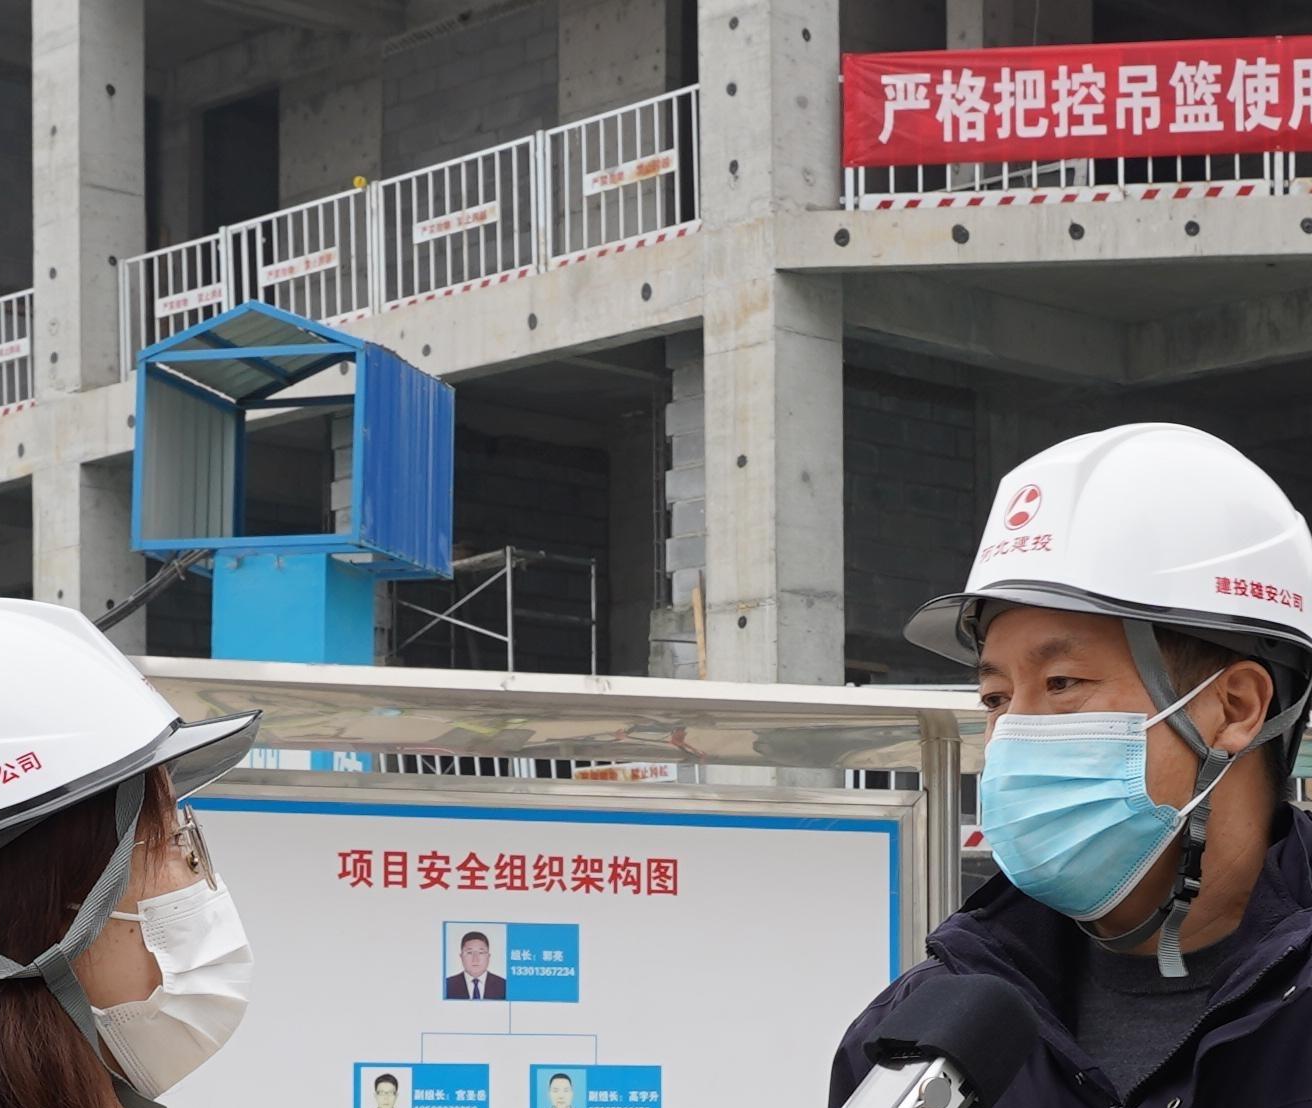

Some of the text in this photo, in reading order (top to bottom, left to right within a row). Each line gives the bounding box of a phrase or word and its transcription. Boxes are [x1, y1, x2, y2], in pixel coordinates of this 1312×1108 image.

[1214, 576, 1304, 612] 建投雄安公司
[337, 848, 680, 897] 项目安全组织架构图
